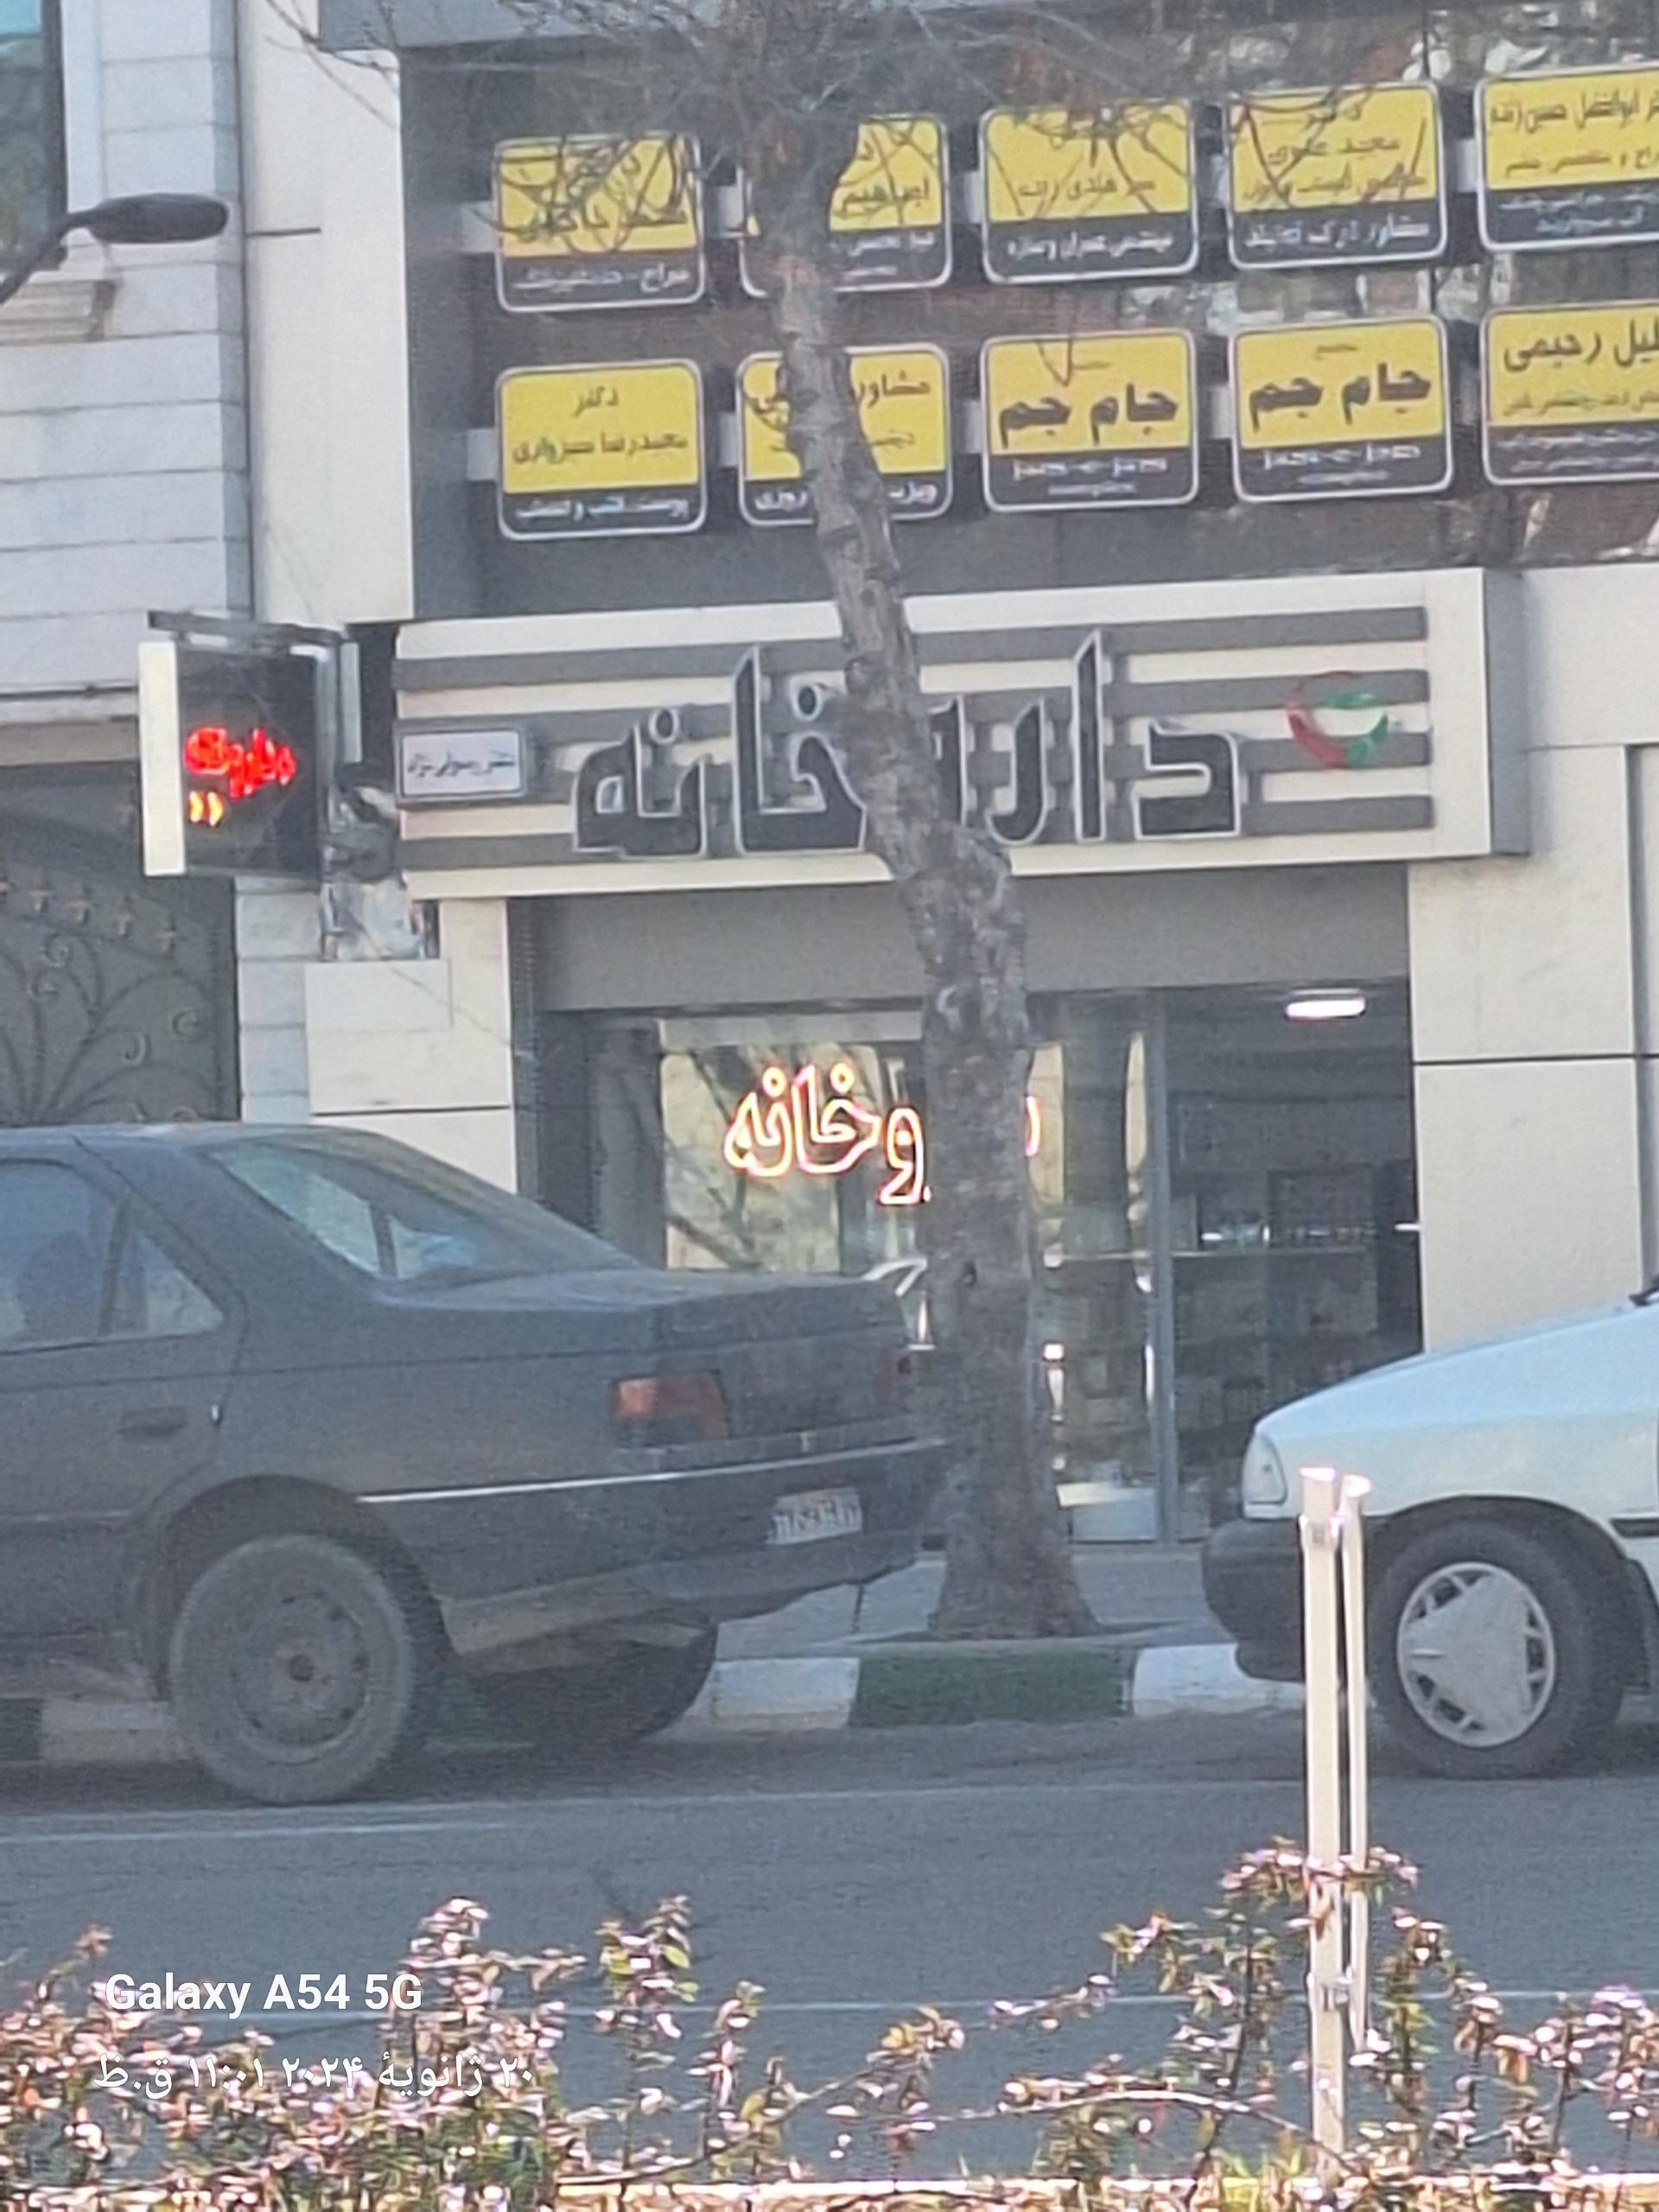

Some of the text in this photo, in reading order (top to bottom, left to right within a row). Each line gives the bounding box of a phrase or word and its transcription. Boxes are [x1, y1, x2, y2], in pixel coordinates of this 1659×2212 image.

[1503, 330, 1603, 373] رحیمی
[570, 385, 620, 418] دکتر
[998, 382, 1179, 450] جام جم
[1249, 377, 1325, 433] جم
[1341, 363, 1433, 425] جام
